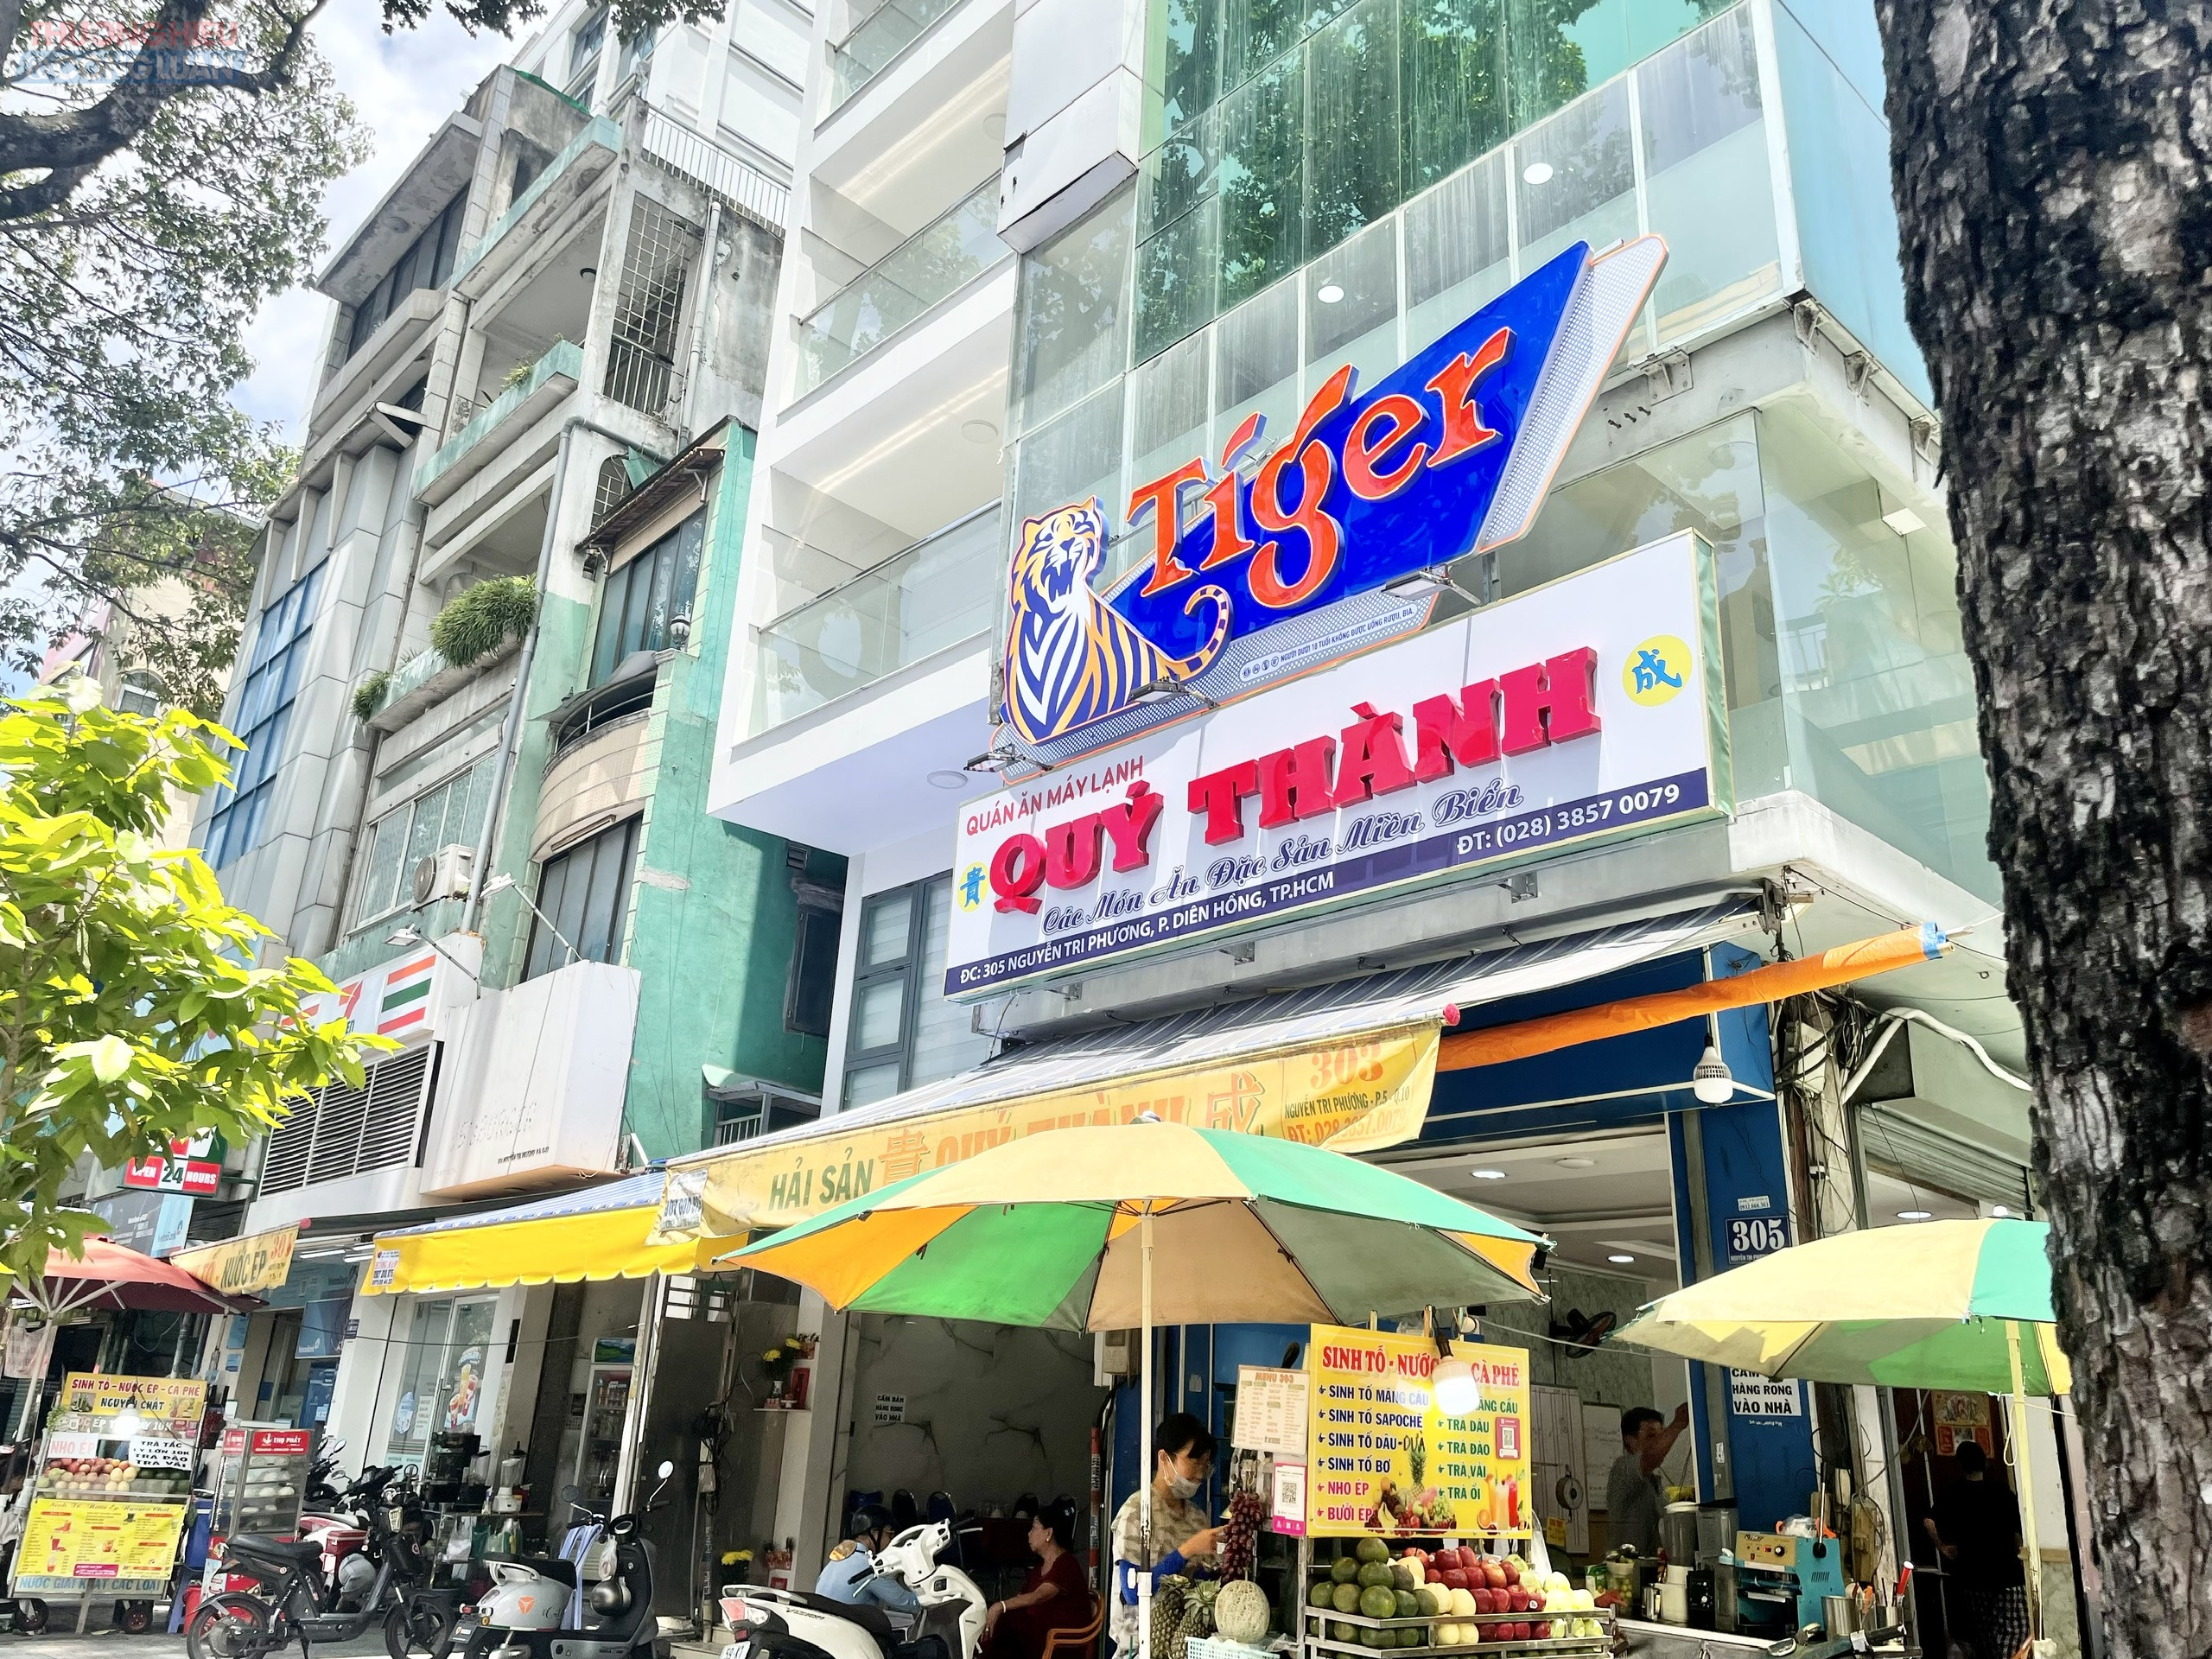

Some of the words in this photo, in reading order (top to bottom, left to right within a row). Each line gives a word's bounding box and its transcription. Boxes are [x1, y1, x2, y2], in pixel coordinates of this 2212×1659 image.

[1125, 326, 1515, 608] Tiger
[1312, 642, 1318, 651] 18
[1332, 631, 1350, 643] KHÔNG
[1631, 649, 1683, 694] 成
[1187, 645, 1602, 846] THÀNH
[966, 799, 1014, 836] QUÁN
[1018, 790, 1043, 819] ĂN
[1047, 774, 1089, 810] MÁY
[1090, 755, 1144, 794] LẠNH
[1457, 833, 1491, 855] ĐT:
[1497, 814, 1552, 849] (028)
[1557, 799, 1613, 831] 3857
[1618, 784, 1681, 814] 0079
[1041, 904, 1084, 935] Các
[1086, 891, 1145, 925] Món
[1148, 865, 1199, 907] Ăn
[1205, 854, 1267, 890] Đặc
[1271, 836, 1332, 871] Sản
[1335, 807, 1425, 855] Miền
[1432, 778, 1523, 828] Biển
[961, 969, 981, 984] ĐC:
[982, 960, 1005, 978] 305
[1007, 940, 1063, 972] NGUYỄN
[1064, 936, 1085, 957] TRI
[1088, 919, 1155, 951] PHƯƠNG,
[1158, 917, 1170, 932] P.
[1173, 904, 1210, 931] DIÊN
[1212, 892, 1267, 918] HỒNG,
[1269, 871, 1334, 903] TP.HCM
[1311, 1043, 1384, 1090] 303
[1285, 1093, 1316, 1120] NGUYỄN
[1316, 1098, 1332, 1114] TRI
[1334, 1092, 1369, 1113] PHƯƠNG
[162, 1166, 183, 1184] 24
[186, 1171, 216, 1185] HOURS
[768, 1156, 813, 1211] HẢI
[819, 1147, 874, 1205] SẢN
[1732, 1219, 1785, 1251] 305
[1322, 1345, 1363, 1370] SINH
[1365, 1345, 1386, 1373] TỐ
[1471, 1359, 1490, 1384] CÀ
[1492, 1363, 1520, 1387] PHÊ
[72, 1379, 94, 1389] SINH
[99, 1376, 110, 1390] TỐ
[147, 1381, 159, 1394] ÉP
[182, 1384, 200, 1396] PHÊ
[1329, 1385, 1354, 1399] SINH
[1358, 1384, 1372, 1401] TỐ
[1732, 1382, 1760, 1395] HÀNG
[1764, 1385, 1792, 1395] RONG
[100, 1397, 137, 1408] NGUYN
[1475, 1396, 1497, 1412] ÃNG
[1733, 1398, 1760, 1413] VÀO
[1764, 1399, 1792, 1414] NHÀ
[1329, 1408, 1354, 1423] SINH
[1358, 1408, 1372, 1424] TỐ
[1376, 1413, 1423, 1428] SAPOCHÊ
[1447, 1416, 1466, 1432] TRÀ
[1470, 1418, 1489, 1433] DÂU
[1329, 1433, 1354, 1447] SINH
[1358, 1431, 1372, 1448] TỐ
[1447, 1440, 1466, 1454] TRÀ
[1470, 1440, 1491, 1455] ĐÀO
[1328, 1457, 1354, 1471] SINH
[1358, 1455, 1372, 1472] TỐ
[1376, 1459, 1391, 1472] BƠ
[1447, 1461, 1466, 1477] TRÀ
[1328, 1481, 1351, 1495] NHO
[1355, 1479, 1369, 1496] ÉP
[1447, 1484, 1467, 1499] TRÀ
[1327, 1502, 1354, 1521] BƯỞI
[1358, 1503, 1373, 1521] ÉP
